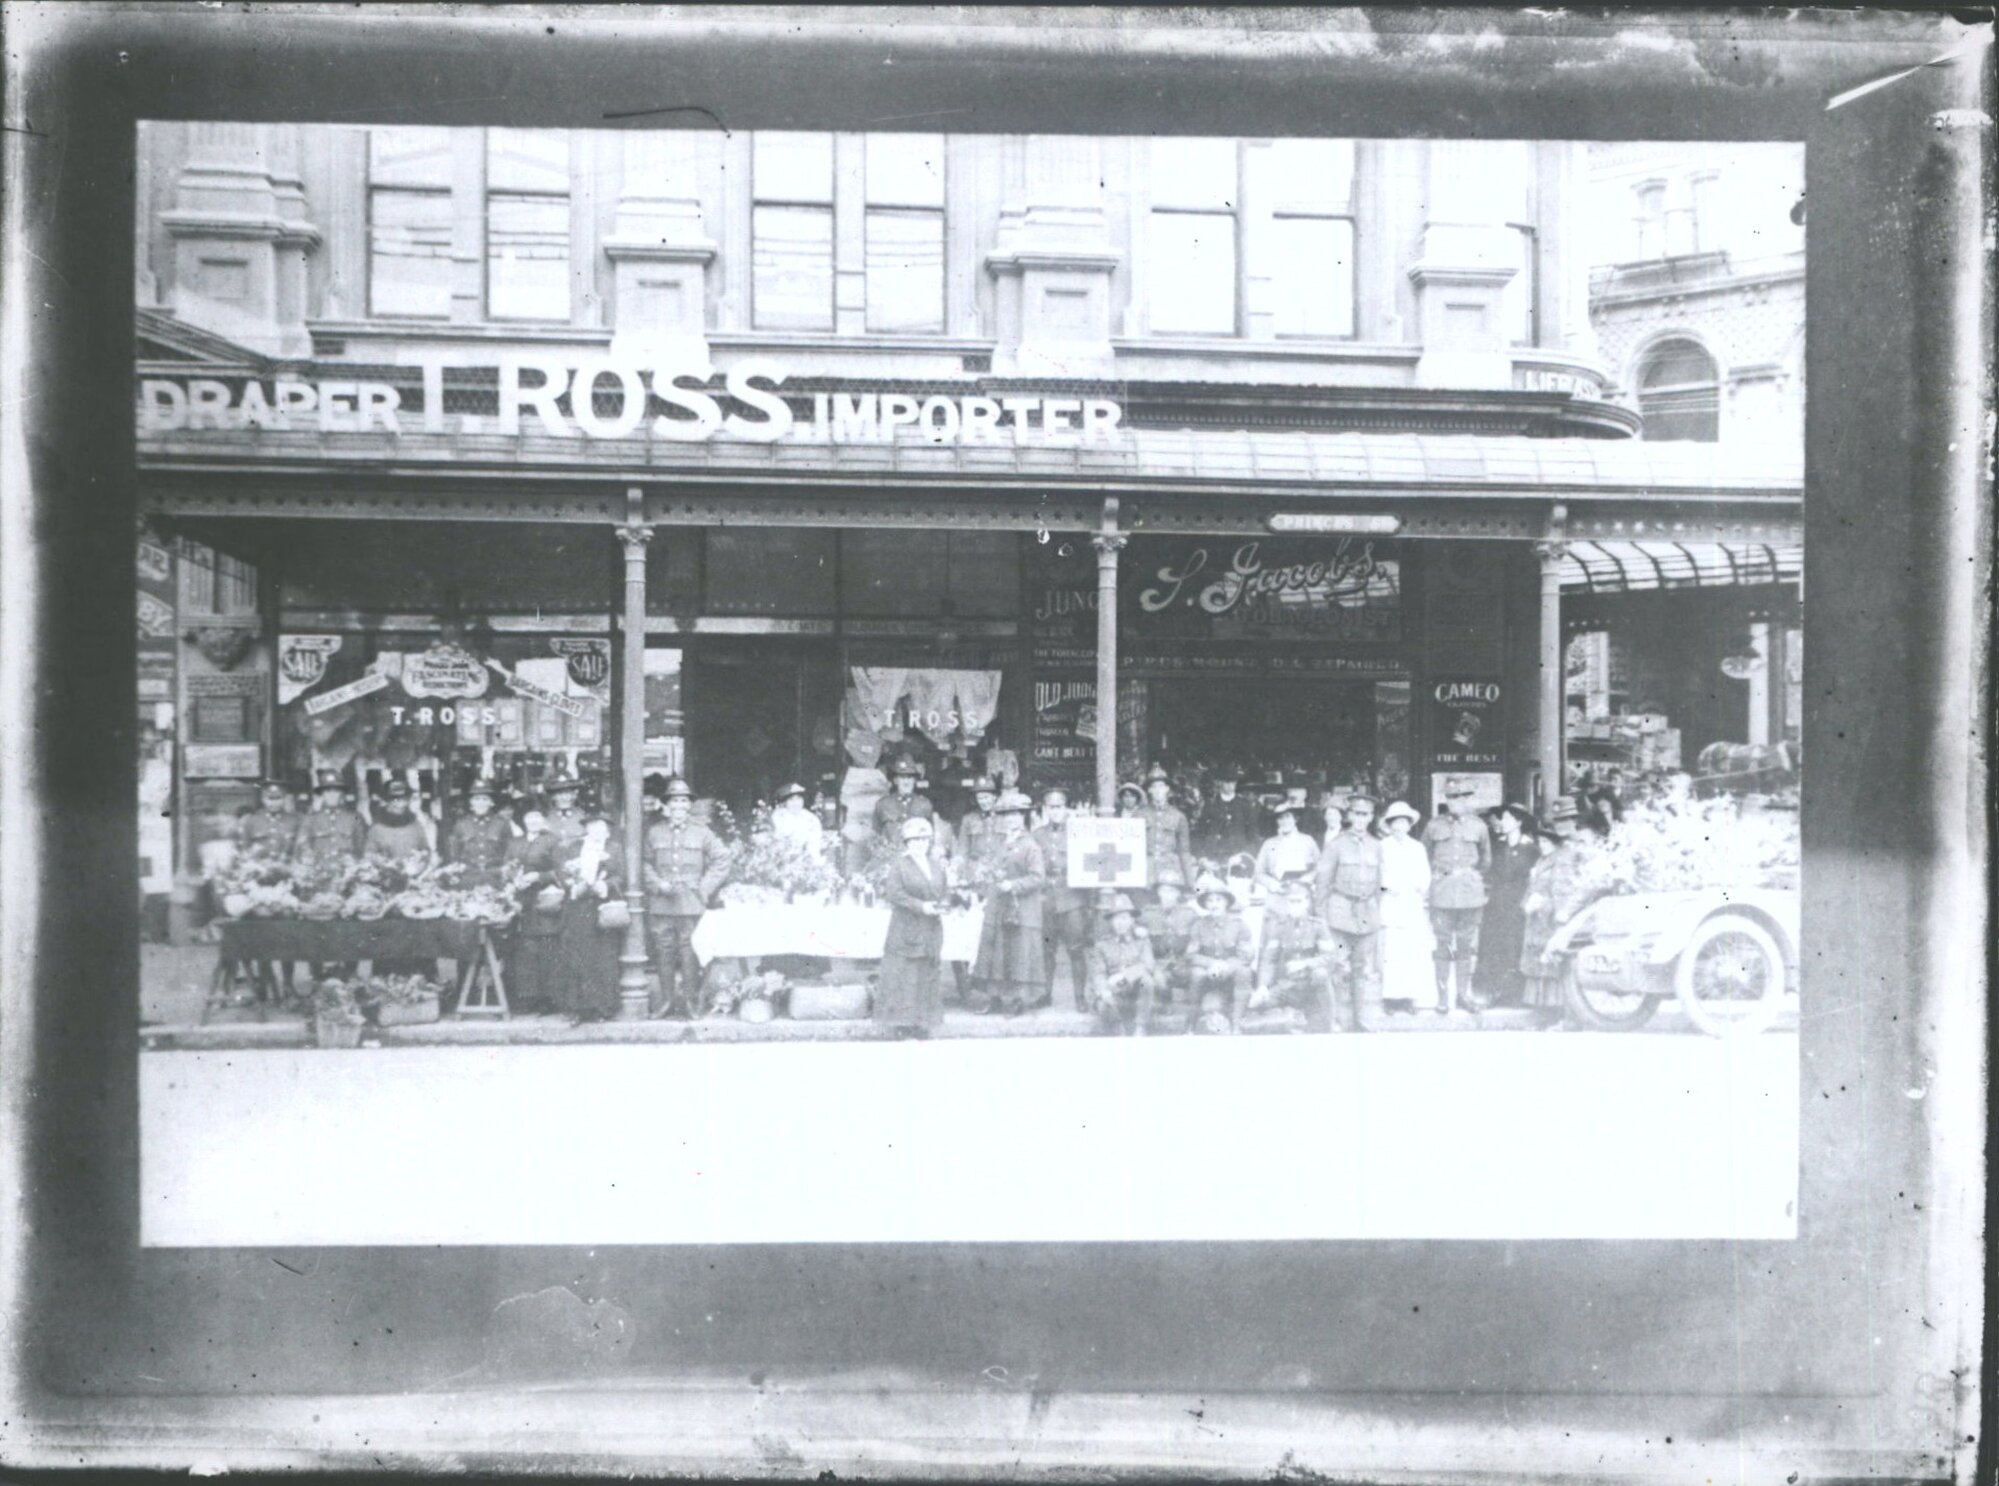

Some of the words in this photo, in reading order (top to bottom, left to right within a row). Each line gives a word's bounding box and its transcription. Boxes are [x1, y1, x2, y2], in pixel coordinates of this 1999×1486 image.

[140, 379, 402, 437] DRAPER
[814, 393, 1123, 446] IMPORTER
[571, 655, 606, 680] SALE
[1034, 682, 1062, 711] OLD
[1062, 682, 1097, 700] JUDG
[1434, 683, 1500, 702] CAMEO
[1436, 754, 1459, 762] THE
[1464, 754, 1497, 762] BEST
